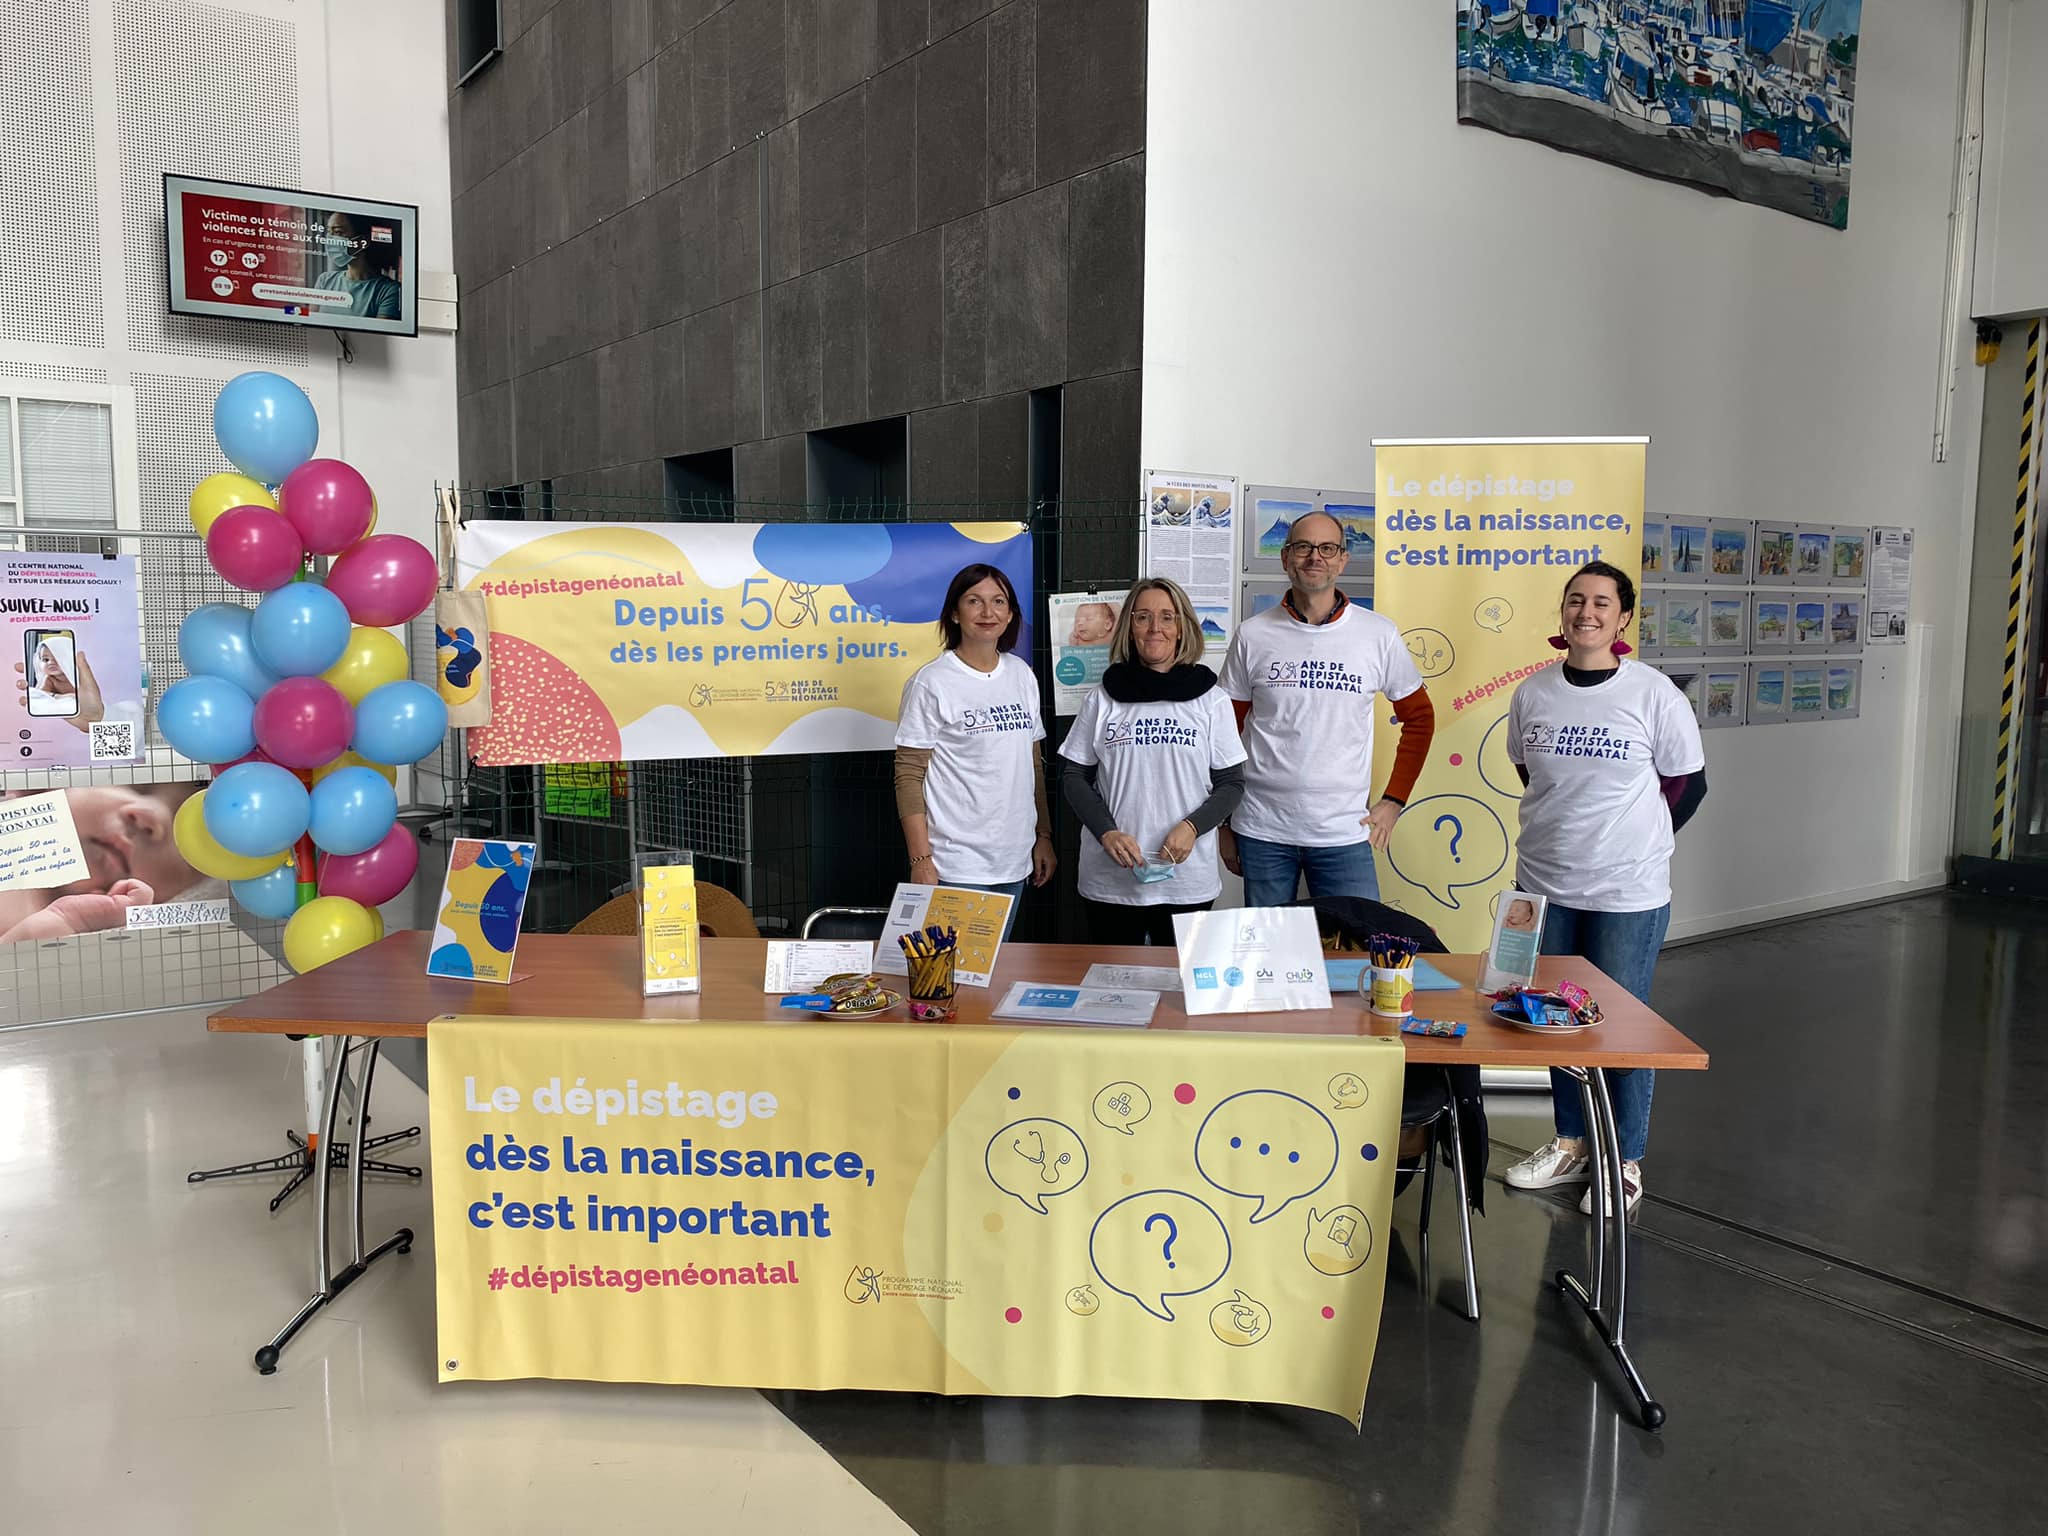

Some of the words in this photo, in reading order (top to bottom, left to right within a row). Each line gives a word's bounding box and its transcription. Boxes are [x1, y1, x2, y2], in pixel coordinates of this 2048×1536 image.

[202, 208, 247, 222] Victime
[250, 217, 264, 225] ou
[268, 217, 307, 230] témoin
[310, 222, 325, 232] de
[202, 222, 256, 236] violences
[258, 227, 290, 240] faites
[292, 234, 313, 243] aux
[316, 234, 359, 248] femmes
[361, 240, 368, 248] ?
[213, 254, 224, 262] 17
[1387, 475, 1420, 498] Le
[1428, 474, 1575, 502] dépistage
[1386, 509, 1436, 532] dès
[1444, 508, 1472, 532] la
[1479, 508, 1632, 534] naissance,
[1385, 544, 1449, 566] c'est
[1456, 544, 1602, 571] important
[480, 571, 684, 598] #dépistagenéonatal
[0, 598, 90, 614] SUIVEZ-NOUS
[95, 598, 100, 614] !
[614, 598, 724, 632] Depuis
[829, 602, 892, 628] ans,
[610, 641, 657, 664] dès
[668, 640, 703, 662] les
[713, 638, 830, 666] premiers
[836, 638, 908, 664] jours.
[1301, 660, 1325, 670] ANS
[1330, 662, 1344, 672] DE
[1300, 668, 1362, 684] DÉPISTAGE
[791, 686, 838, 694] DÉPISTAGE
[1300, 677, 1362, 694] NÉONATAL
[791, 694, 838, 702] NÉONATAL
[990, 704, 1009, 714] ANS
[1010, 704, 1022, 712] DE
[993, 711, 1032, 722] DÉPISTA
[1136, 718, 1160, 726] ANS
[1164, 718, 1178, 726] DE
[1135, 726, 1198, 738] DÉPISTAGE
[1560, 726, 1588, 736] ANS
[1592, 727, 1610, 736] DE
[1135, 734, 1196, 747] NÉONATAL
[1557, 733, 1630, 750] DÉPISTAGE
[1554, 745, 1628, 760] NÉONATAL
[29, 840, 40, 849] 50
[156, 904, 182, 914] ANS
[190, 902, 207, 910] DE
[845, 996, 877, 1008] HARIBO
[1028, 992, 1071, 1000] HCL
[464, 1076, 522, 1114] Le
[532, 1077, 779, 1129] dépistage
[464, 1134, 551, 1172] dès
[563, 1136, 609, 1174] la
[620, 1138, 876, 1187] naissance,
[467, 1192, 576, 1231] c'est
[588, 1194, 832, 1244] important
[488, 1260, 800, 1293] #dépistagenéonatal
[882, 1276, 925, 1285] PROGRAMME
[928, 1278, 964, 1287] NATIONAL
[894, 1283, 927, 1292] DÉPISTAGE
[928, 1284, 964, 1294] NÉONATAL
